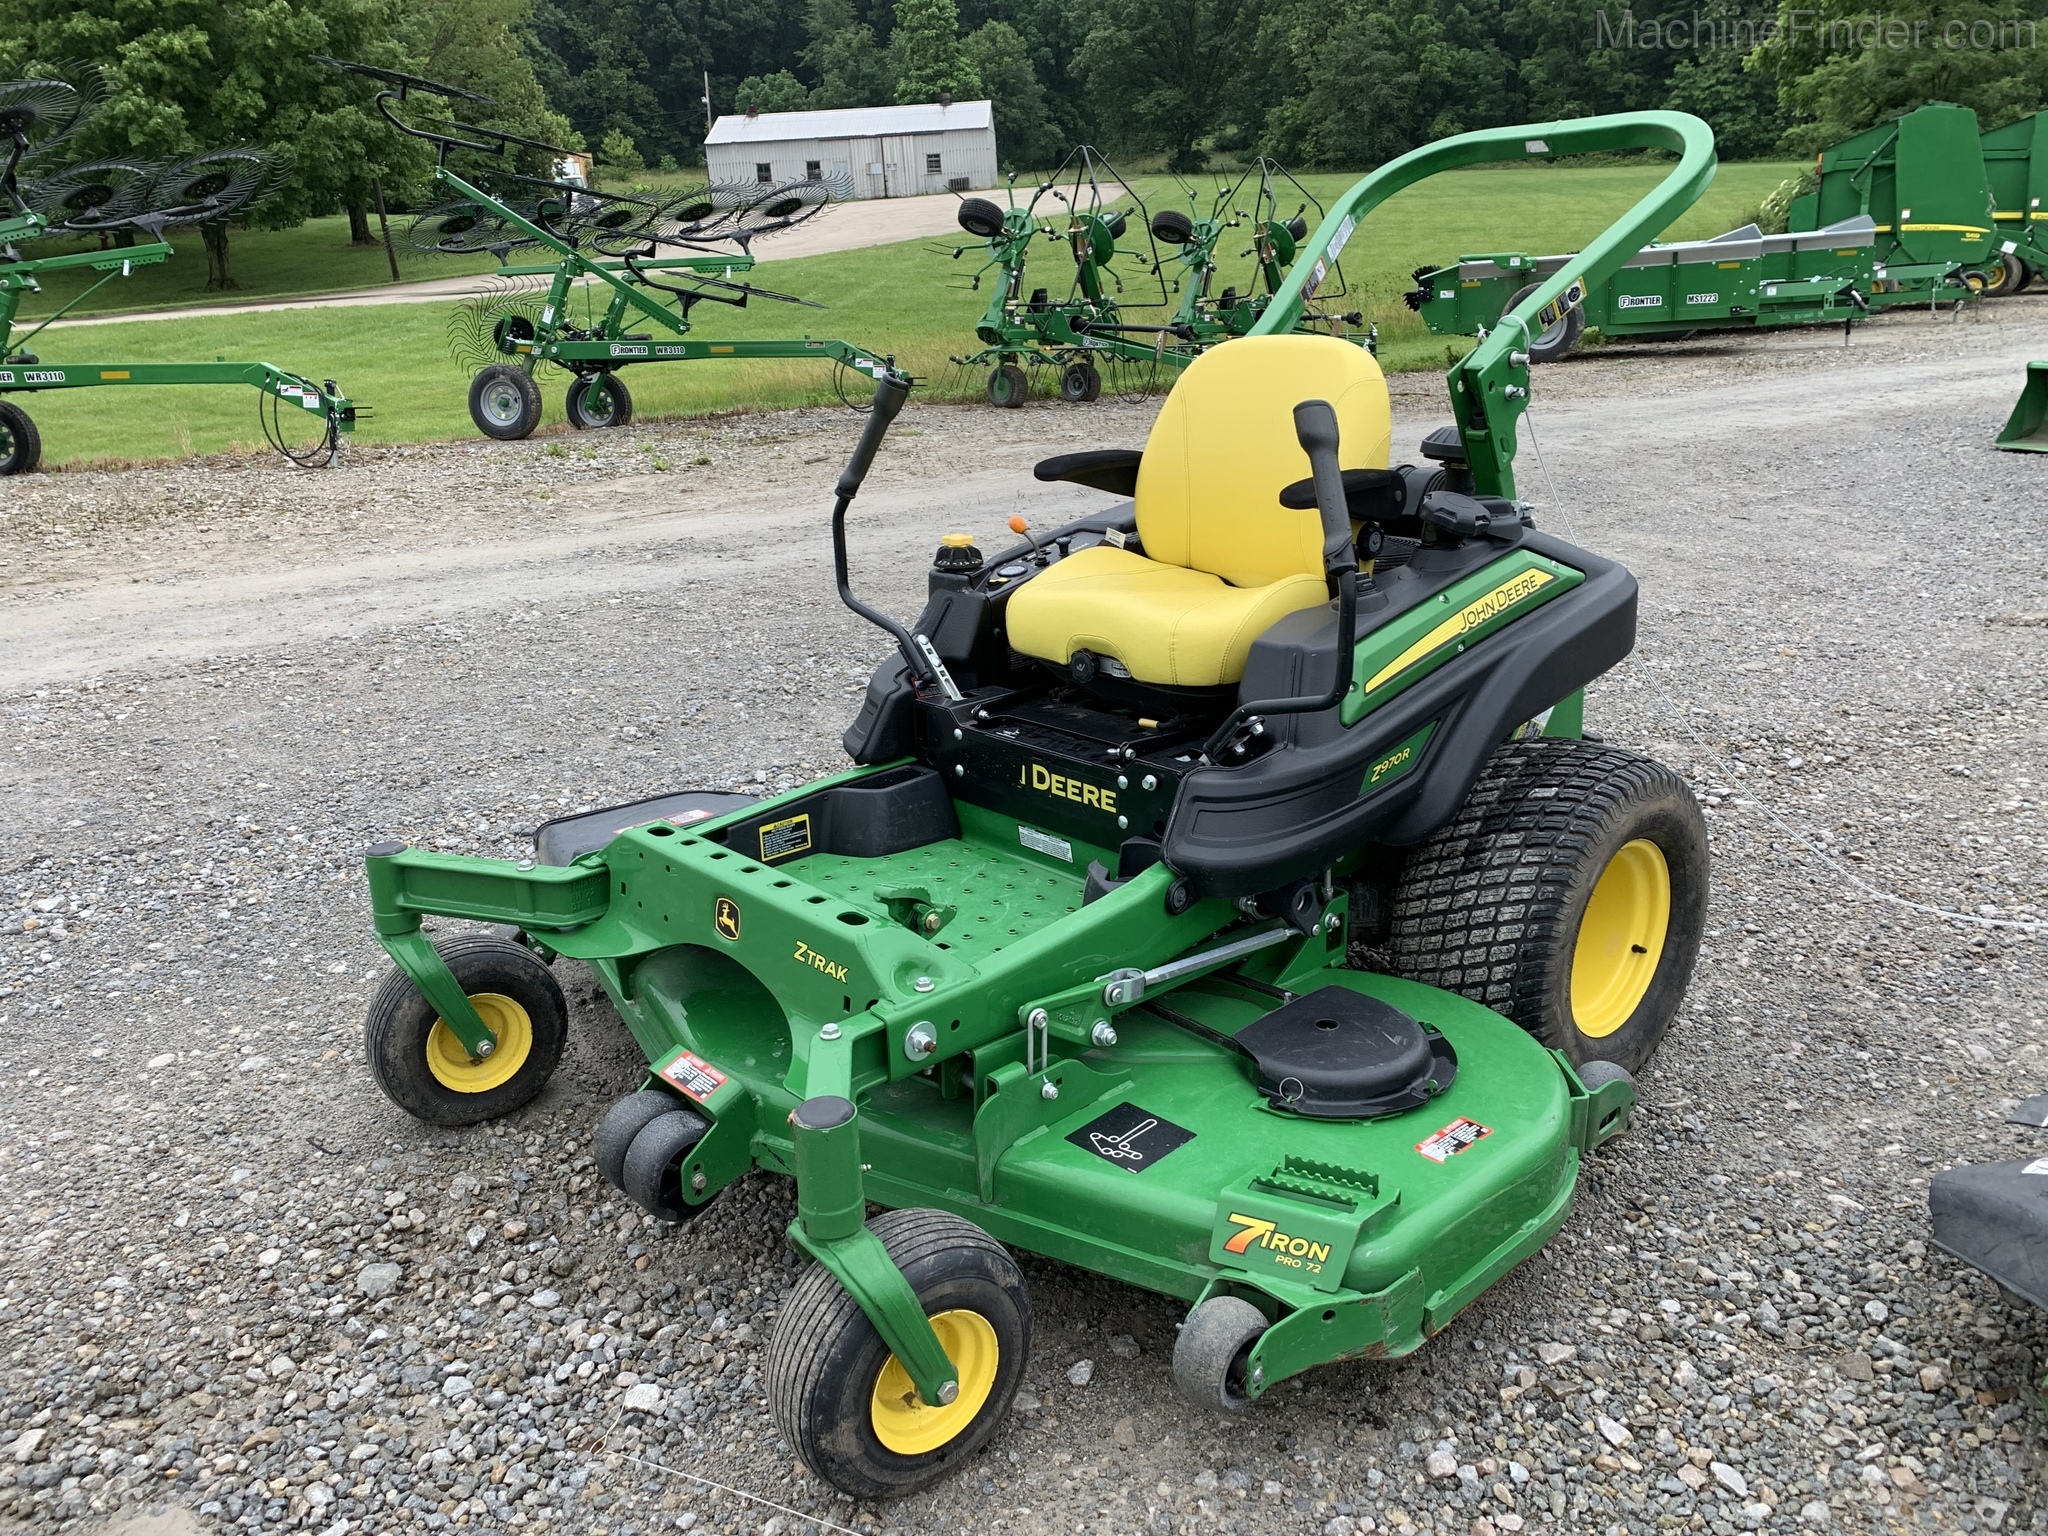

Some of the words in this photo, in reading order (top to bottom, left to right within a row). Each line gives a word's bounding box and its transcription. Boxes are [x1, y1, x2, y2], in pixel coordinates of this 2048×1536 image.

[1619, 296, 1661, 308] FRONTIER
[1687, 293, 1718, 304] MS1223
[611, 345, 647, 355] FRONTIER
[656, 346, 684, 355] WR3110
[25, 371, 65, 382] WR3110
[1460, 599, 1496, 630] JOHN
[1496, 575, 1538, 608] DEERE
[1370, 747, 1411, 783] Z970R
[1032, 764, 1117, 813] DEERE
[794, 940, 849, 984] ZTRAK
[1275, 1254, 1302, 1268] PRO
[1306, 1262, 1322, 1274] 72
